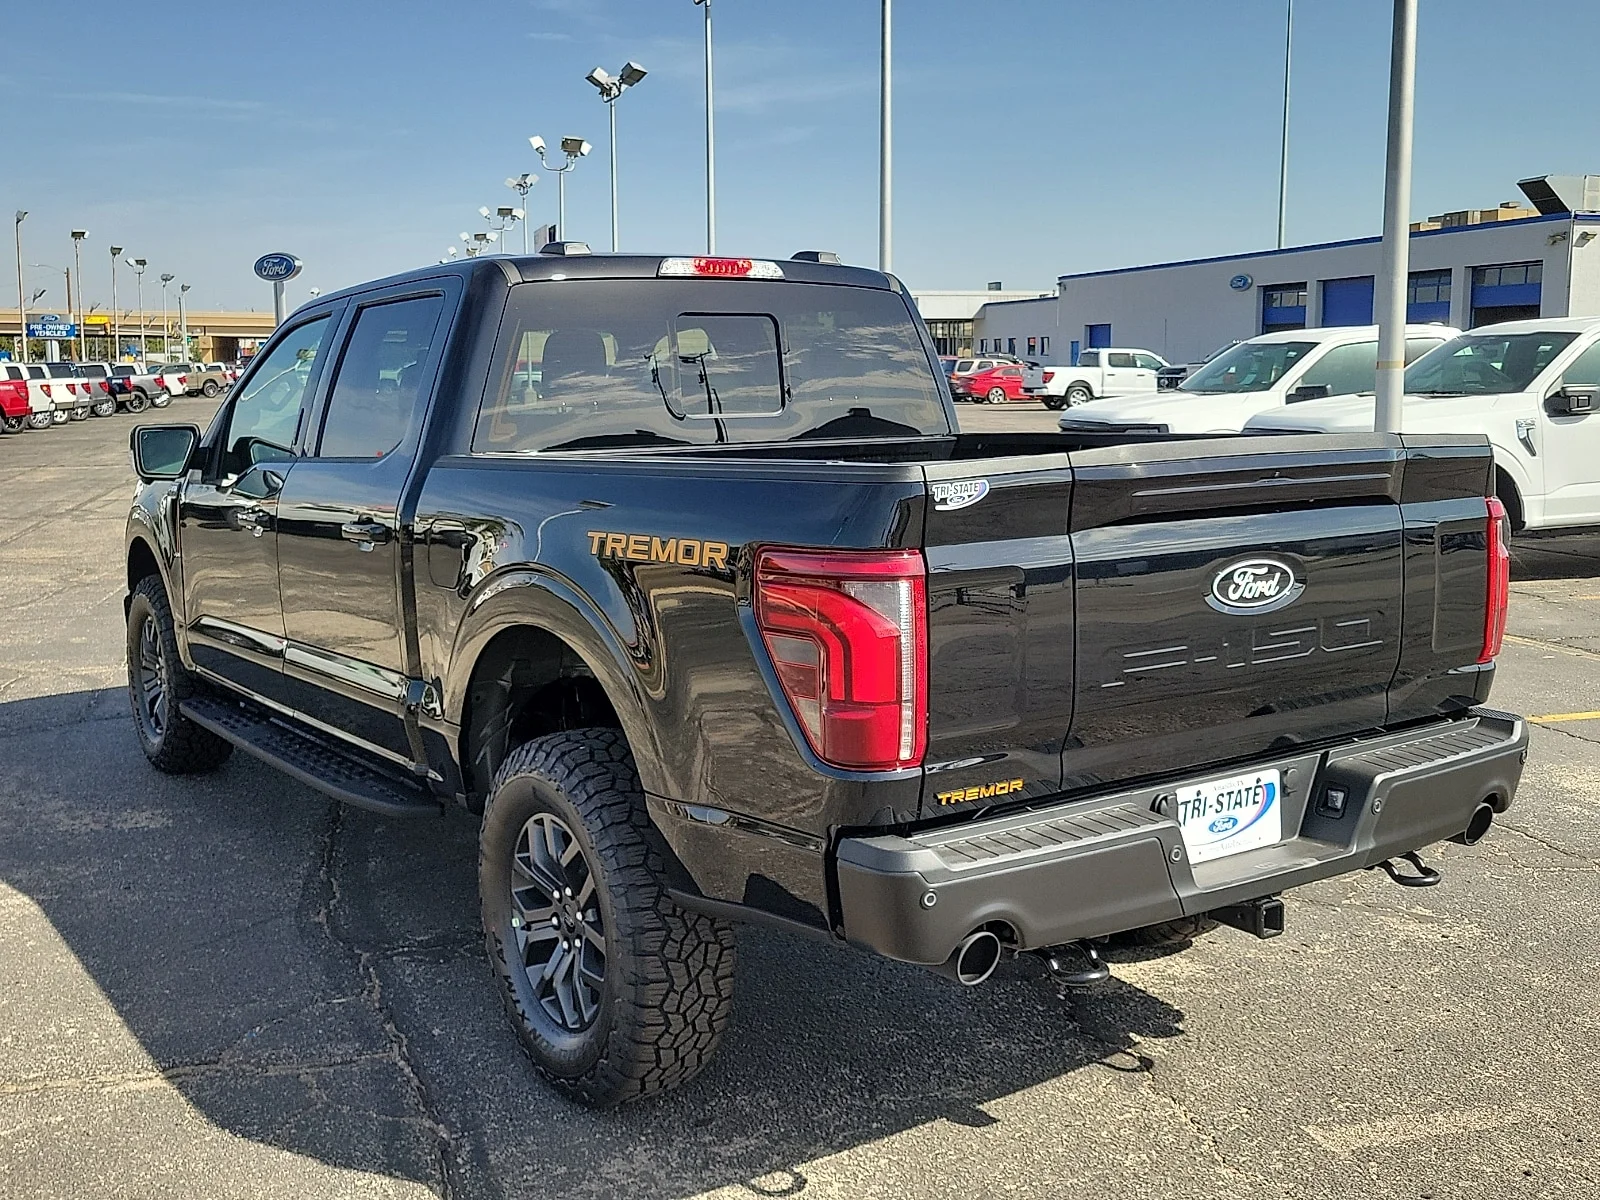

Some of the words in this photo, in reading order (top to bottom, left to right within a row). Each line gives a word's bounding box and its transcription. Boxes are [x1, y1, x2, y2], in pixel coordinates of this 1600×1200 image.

[262, 258, 287, 275] Ford
[934, 483, 979, 498] TRI-STATE
[587, 530, 729, 571] TREMOR
[1228, 566, 1280, 601] Ford
[1101, 611, 1384, 689] F-150
[936, 777, 1025, 806] TREMOR
[1180, 784, 1263, 827] TRI-STATE
